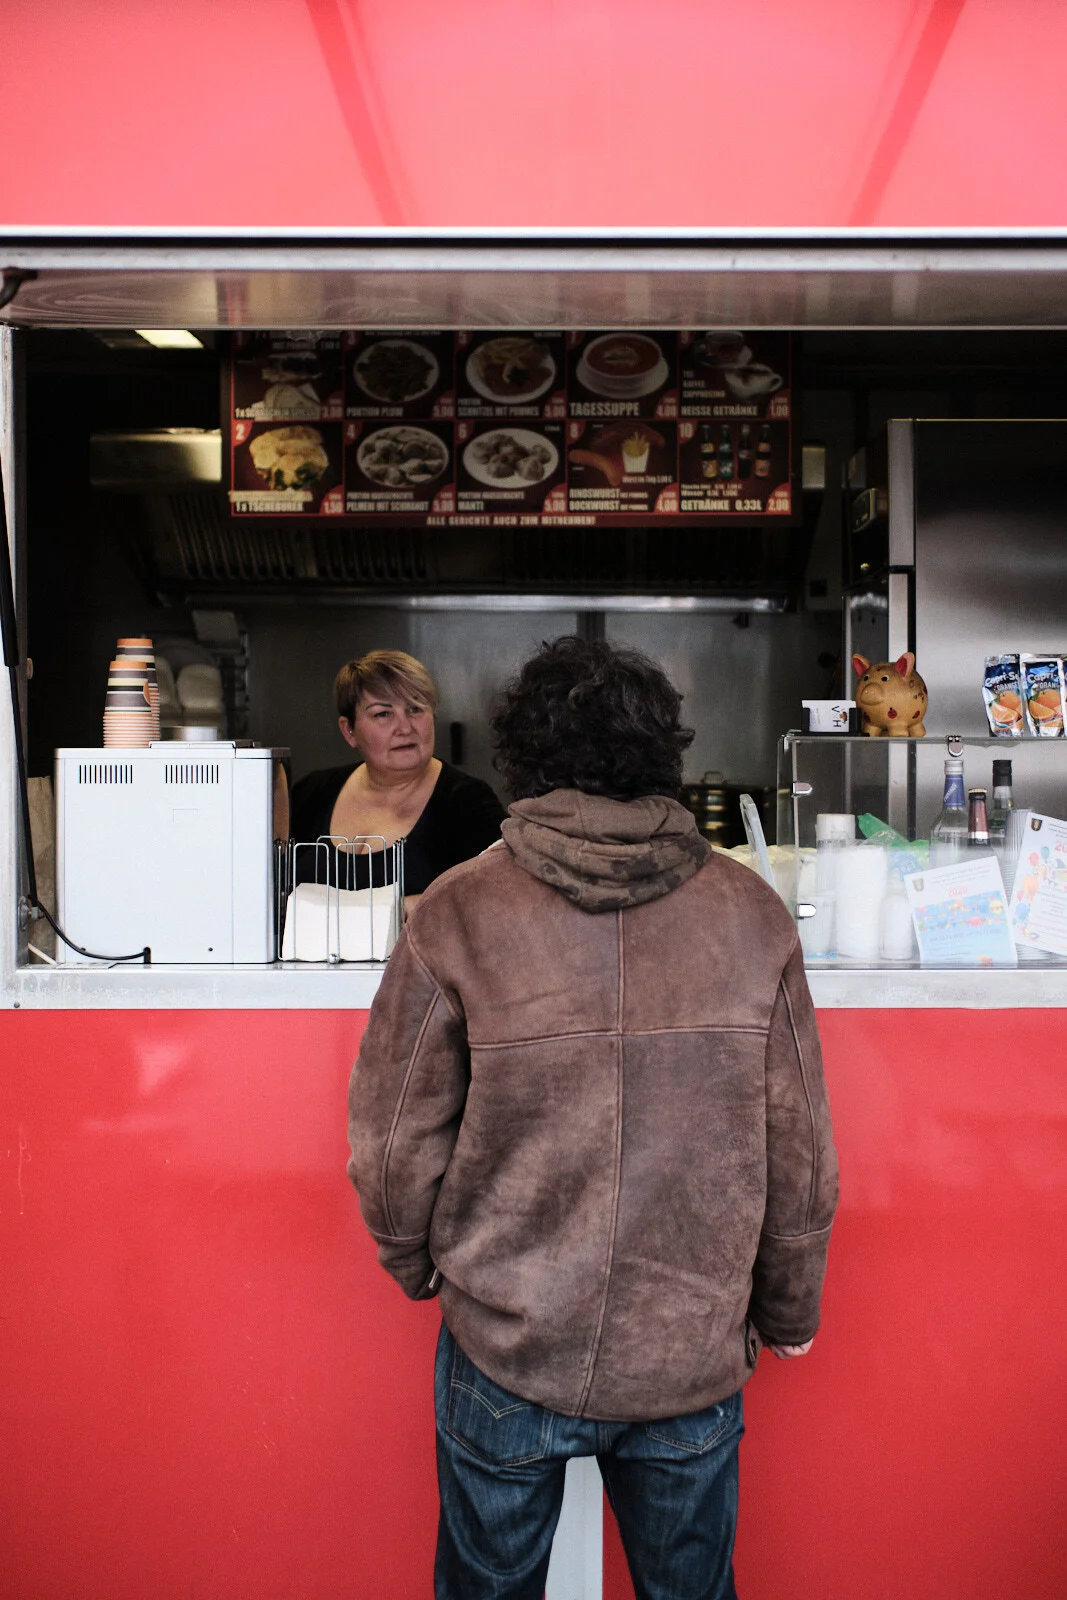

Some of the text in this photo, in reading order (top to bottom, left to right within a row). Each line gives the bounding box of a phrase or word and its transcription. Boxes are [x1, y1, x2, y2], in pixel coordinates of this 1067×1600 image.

[569, 402, 640, 416] TAGESSUPPE
[681, 403, 758, 416] HEISSE GETRÄNKE
[236, 423, 246, 440] 2
[679, 422, 694, 438] 10
[569, 488, 620, 499] RINDSWURST
[569, 500, 620, 511] BOCKWURST
[680, 498, 730, 511] GETRÄNKE
[426, 516, 446, 525] ALLE
[448, 515, 491, 526] GERICHTE
[493, 515, 517, 525] AUCH
[519, 515, 539, 525] ZUM
[1027, 669, 1060, 684] Capri-
